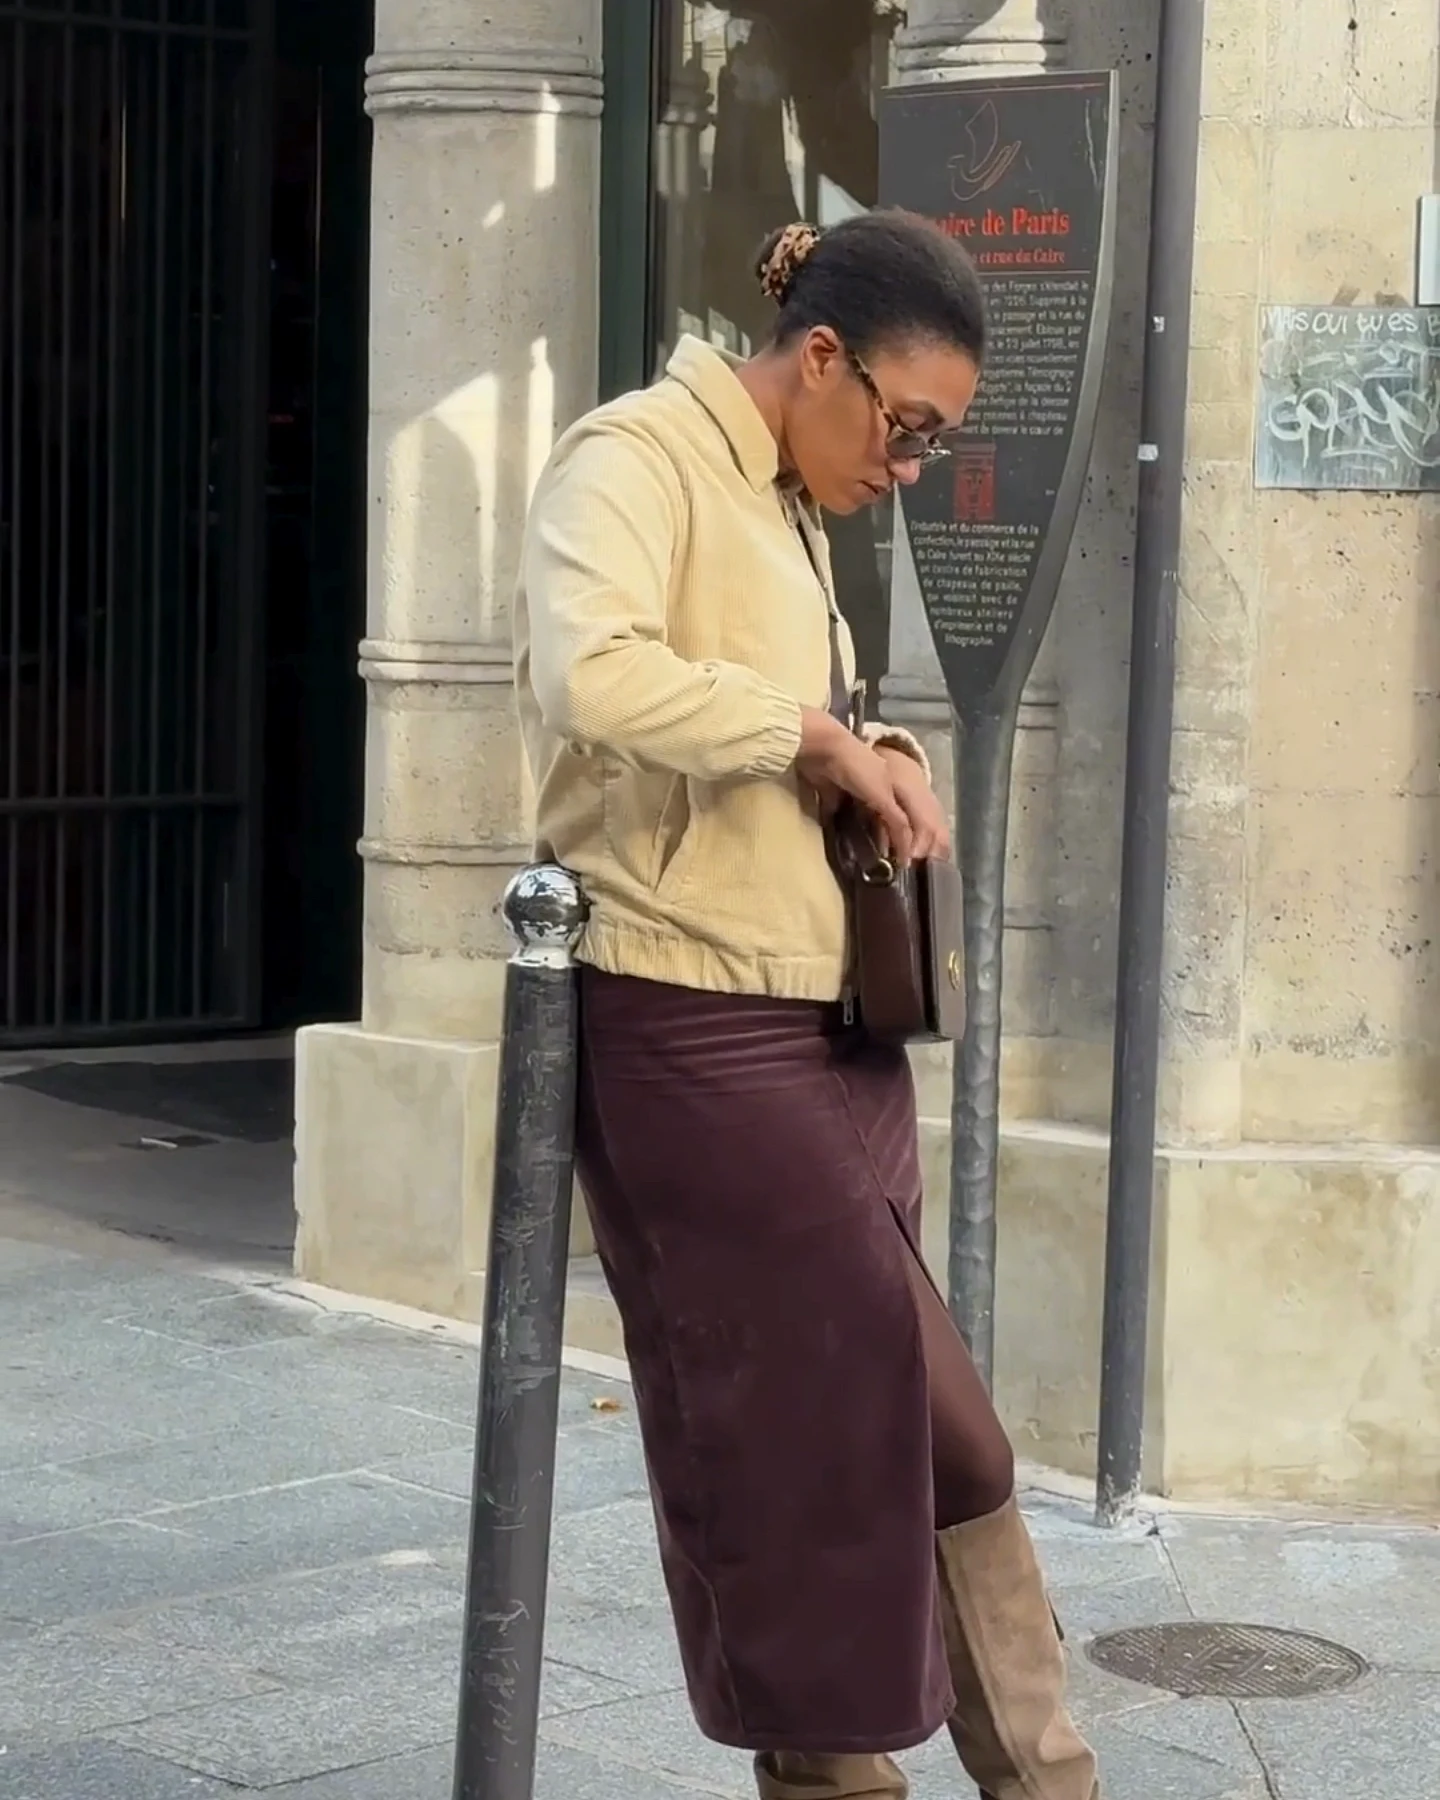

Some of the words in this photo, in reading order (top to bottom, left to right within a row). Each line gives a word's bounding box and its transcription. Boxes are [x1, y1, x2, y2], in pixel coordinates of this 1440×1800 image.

[981, 208, 1005, 236] de
[1011, 207, 1070, 236] Paris
[992, 251, 1014, 263] rue
[1015, 249, 1032, 263] du
[1033, 248, 1065, 263] Caire
[949, 523, 959, 532] et
[960, 522, 970, 533] du
[1017, 524, 1028, 535] de
[1030, 524, 1039, 535] la
[981, 579, 992, 590] de
